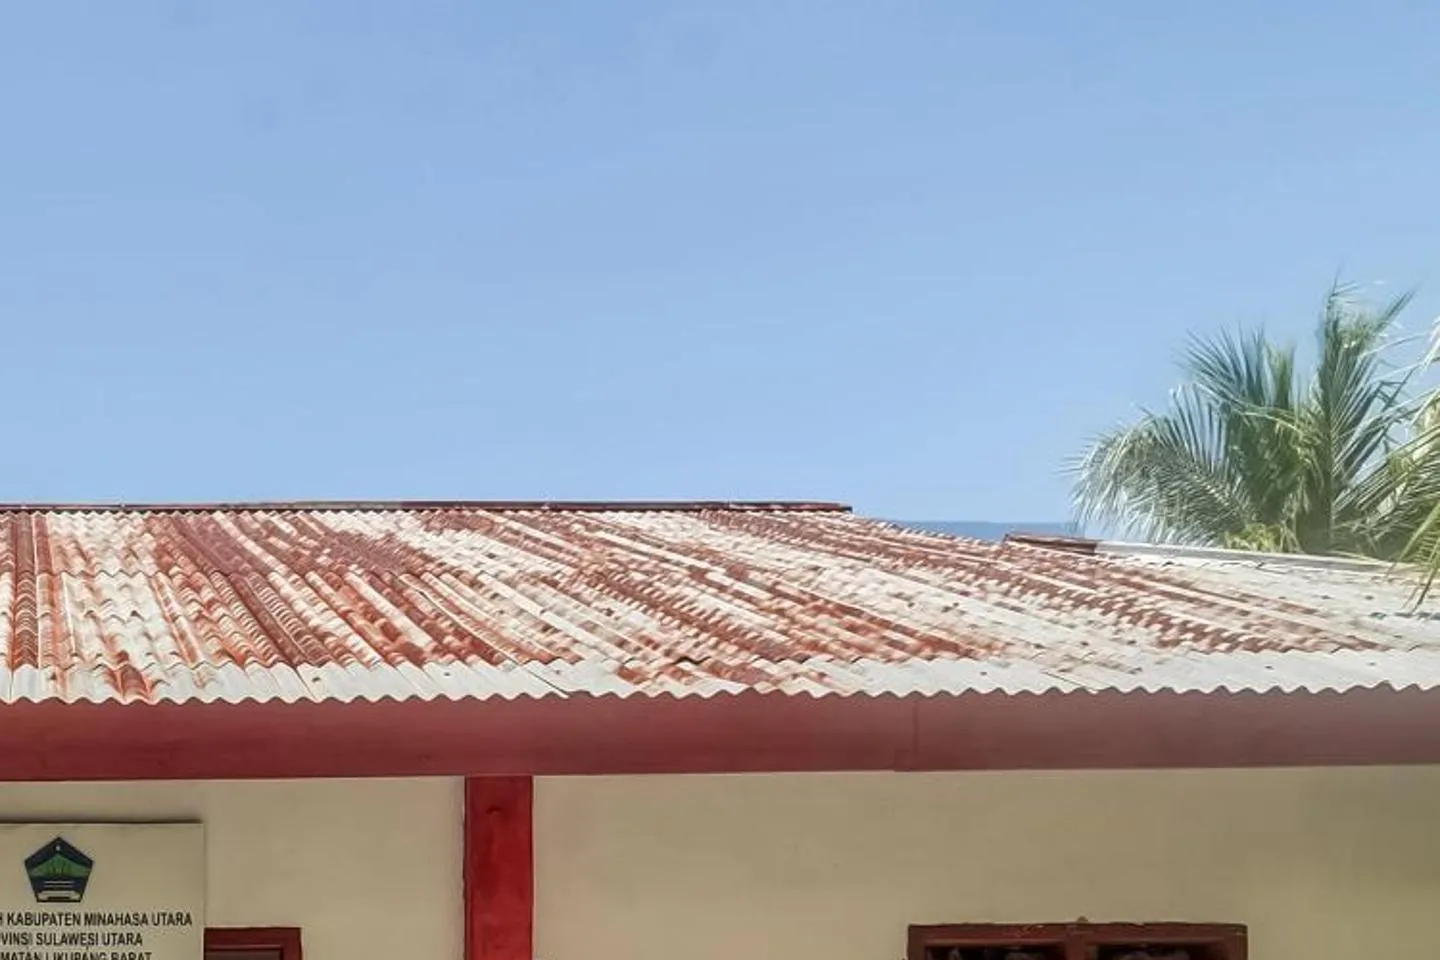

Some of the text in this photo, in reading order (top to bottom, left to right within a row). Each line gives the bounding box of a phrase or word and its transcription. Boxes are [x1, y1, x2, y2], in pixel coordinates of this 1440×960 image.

[7, 911, 81, 926] KABUPATEN
[84, 912, 149, 927] MINAHASA
[152, 912, 193, 926] UTARA
[35, 932, 99, 946] SULAWESI
[101, 932, 144, 946] UTARA
